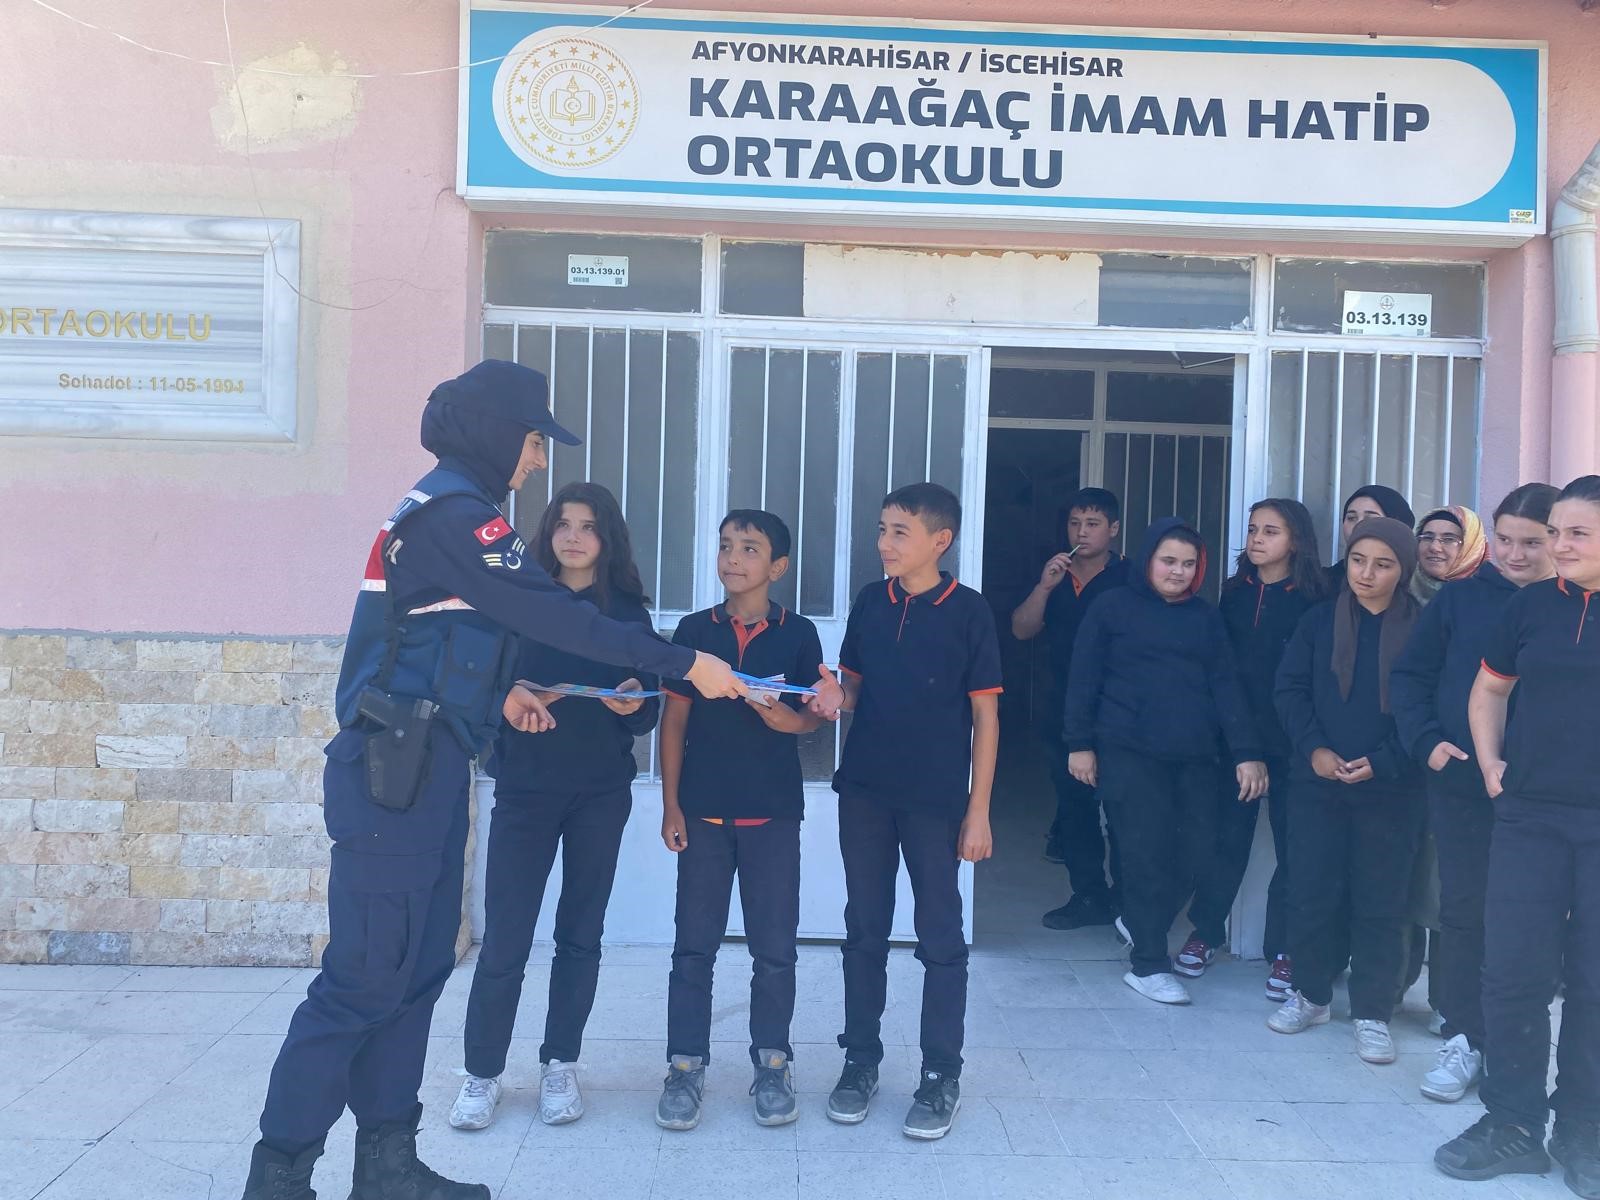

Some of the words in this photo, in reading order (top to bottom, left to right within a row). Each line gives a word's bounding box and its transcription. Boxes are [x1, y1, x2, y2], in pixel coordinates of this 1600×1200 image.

[691, 40, 950, 71] AFYONKARAHİSAR
[958, 51, 972, 73] /
[980, 49, 1123, 77] İSCEHİSAR
[689, 77, 1031, 140] KARAAĞAÇ
[1050, 82, 1227, 137] İMAM
[1248, 91, 1430, 142] HATİP
[687, 134, 1063, 189] ORTAOKULU
[570, 266, 625, 276] 03.13.139.01
[1346, 311, 1428, 326] 03.13.139
